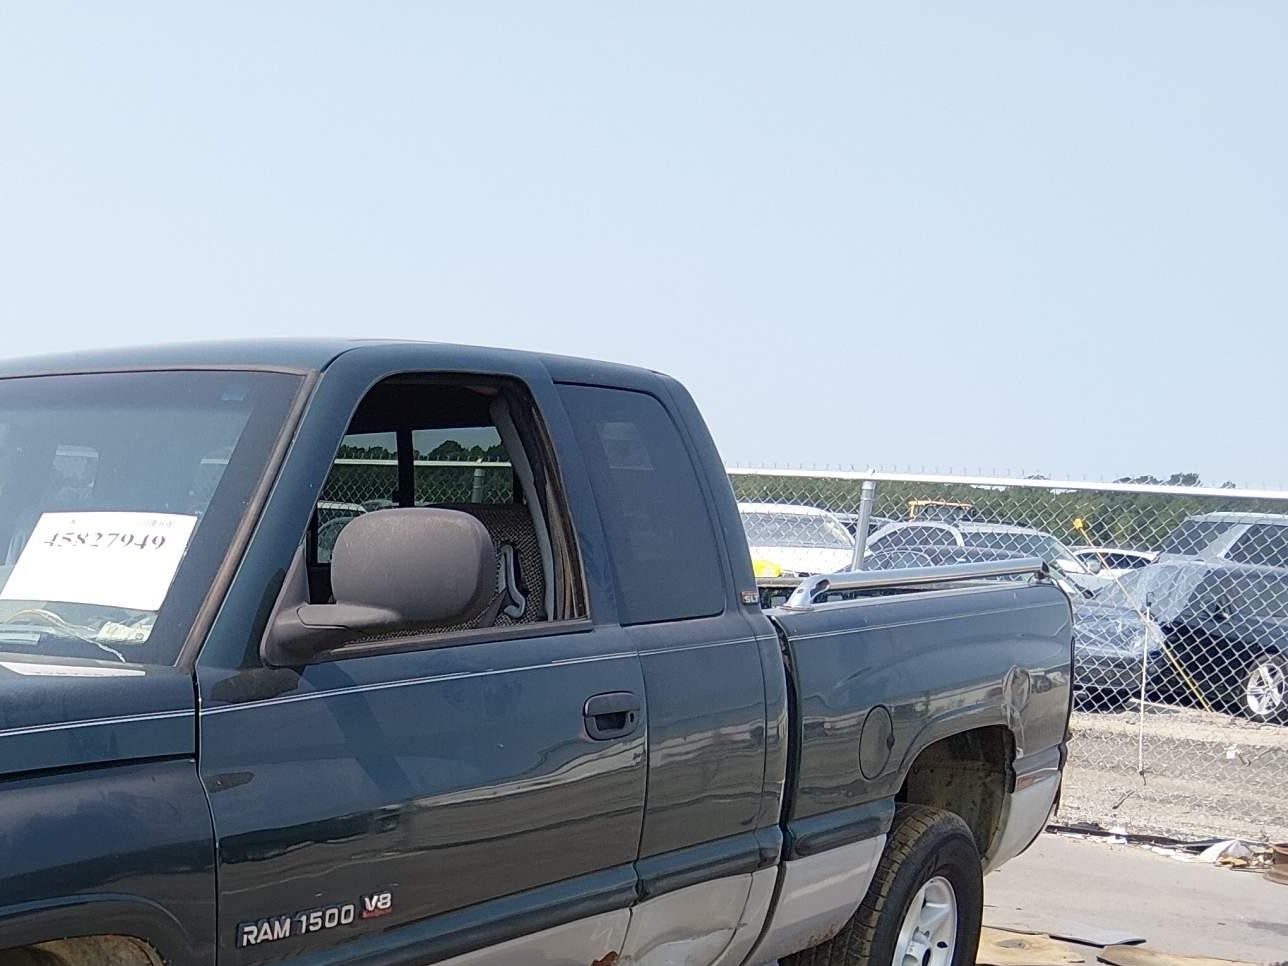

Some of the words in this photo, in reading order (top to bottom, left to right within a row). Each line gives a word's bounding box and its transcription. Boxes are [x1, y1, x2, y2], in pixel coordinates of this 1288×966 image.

[43, 532, 167, 550] 45827949
[242, 918, 291, 947] RAM
[295, 904, 355, 934] 1500
[364, 893, 392, 912] V8
